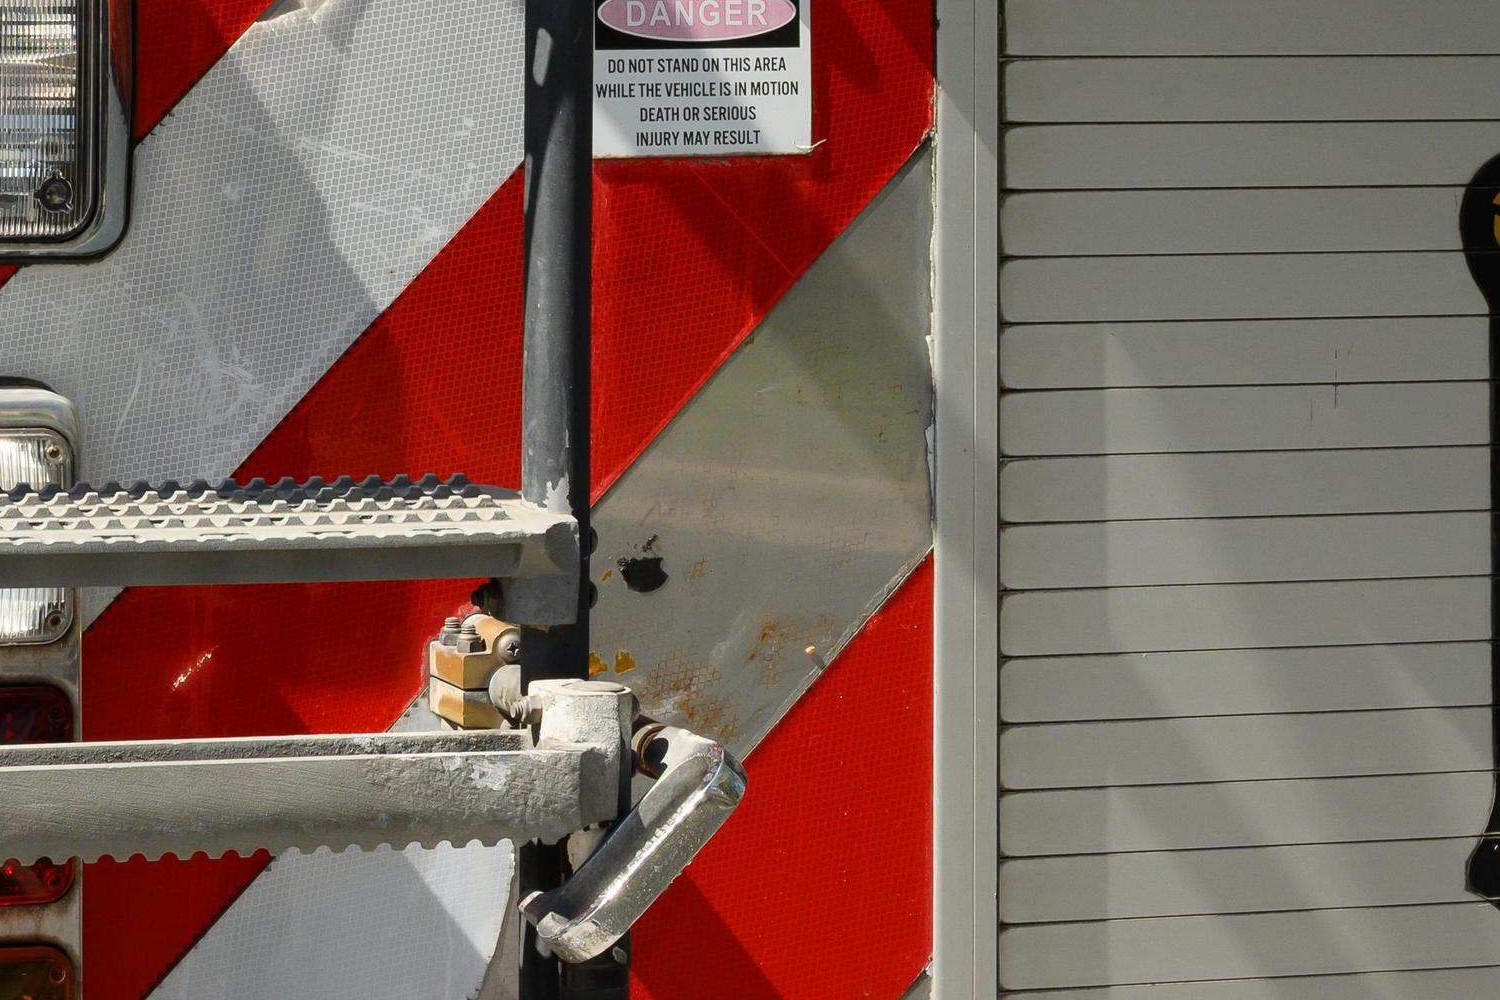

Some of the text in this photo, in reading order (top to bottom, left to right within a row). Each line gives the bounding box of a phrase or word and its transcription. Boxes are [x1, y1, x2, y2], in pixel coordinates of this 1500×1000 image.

[626, 0, 767, 27] DANGER
[608, 57, 786, 74] DO NOT STAND ON THIS AREA
[595, 81, 799, 98] WHILE THE VEHICLE IS IN MOTION
[640, 106, 757, 122] DEATH OR SERIOUS
[636, 130, 761, 147] INJURY MAY RESULT
